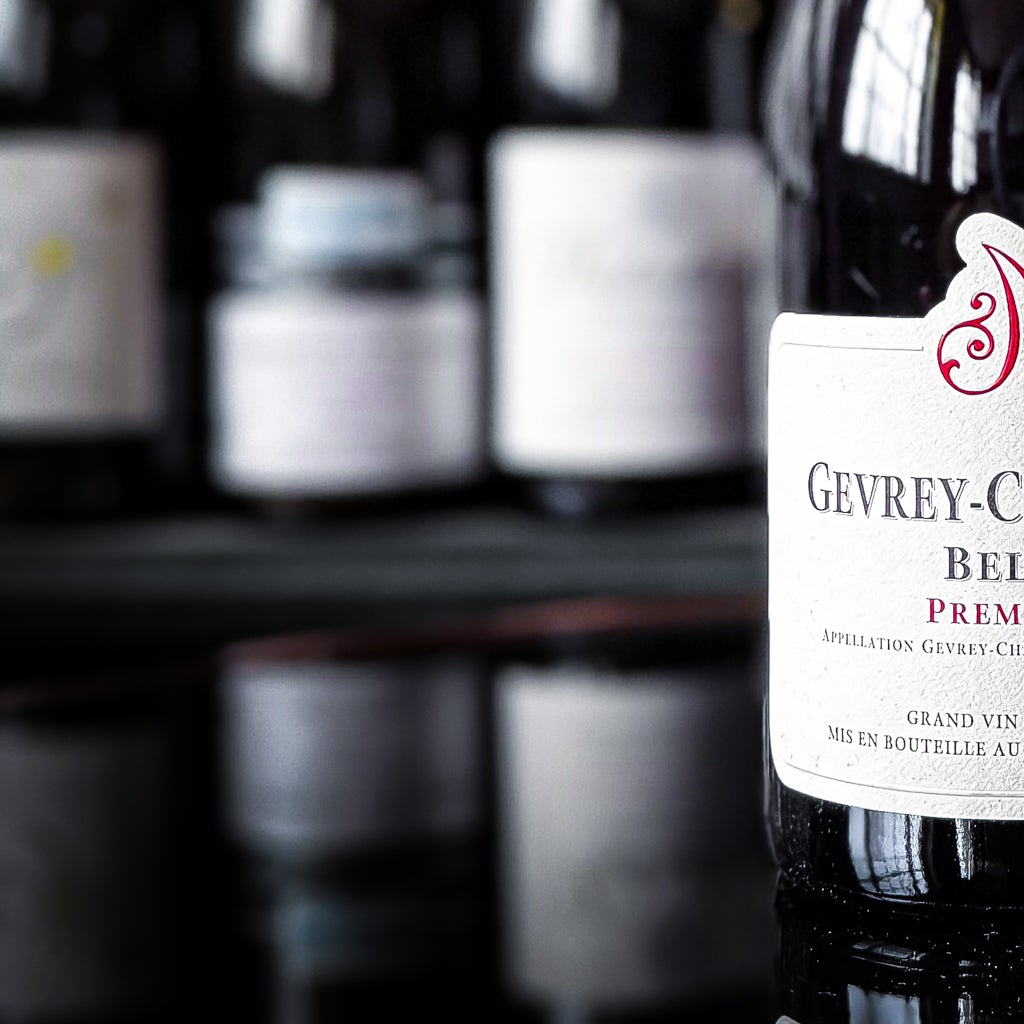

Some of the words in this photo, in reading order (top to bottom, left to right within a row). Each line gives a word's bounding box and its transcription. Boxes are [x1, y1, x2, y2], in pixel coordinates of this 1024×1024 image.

[822, 628, 913, 653] APPELLATION
[906, 710, 974, 728] GRAND
[981, 713, 1018, 729] VIN
[827, 725, 853, 744] MIS
[858, 731, 878, 748] EN
[883, 734, 987, 757] BOUTEILLE
[992, 741, 1020, 757] AU
